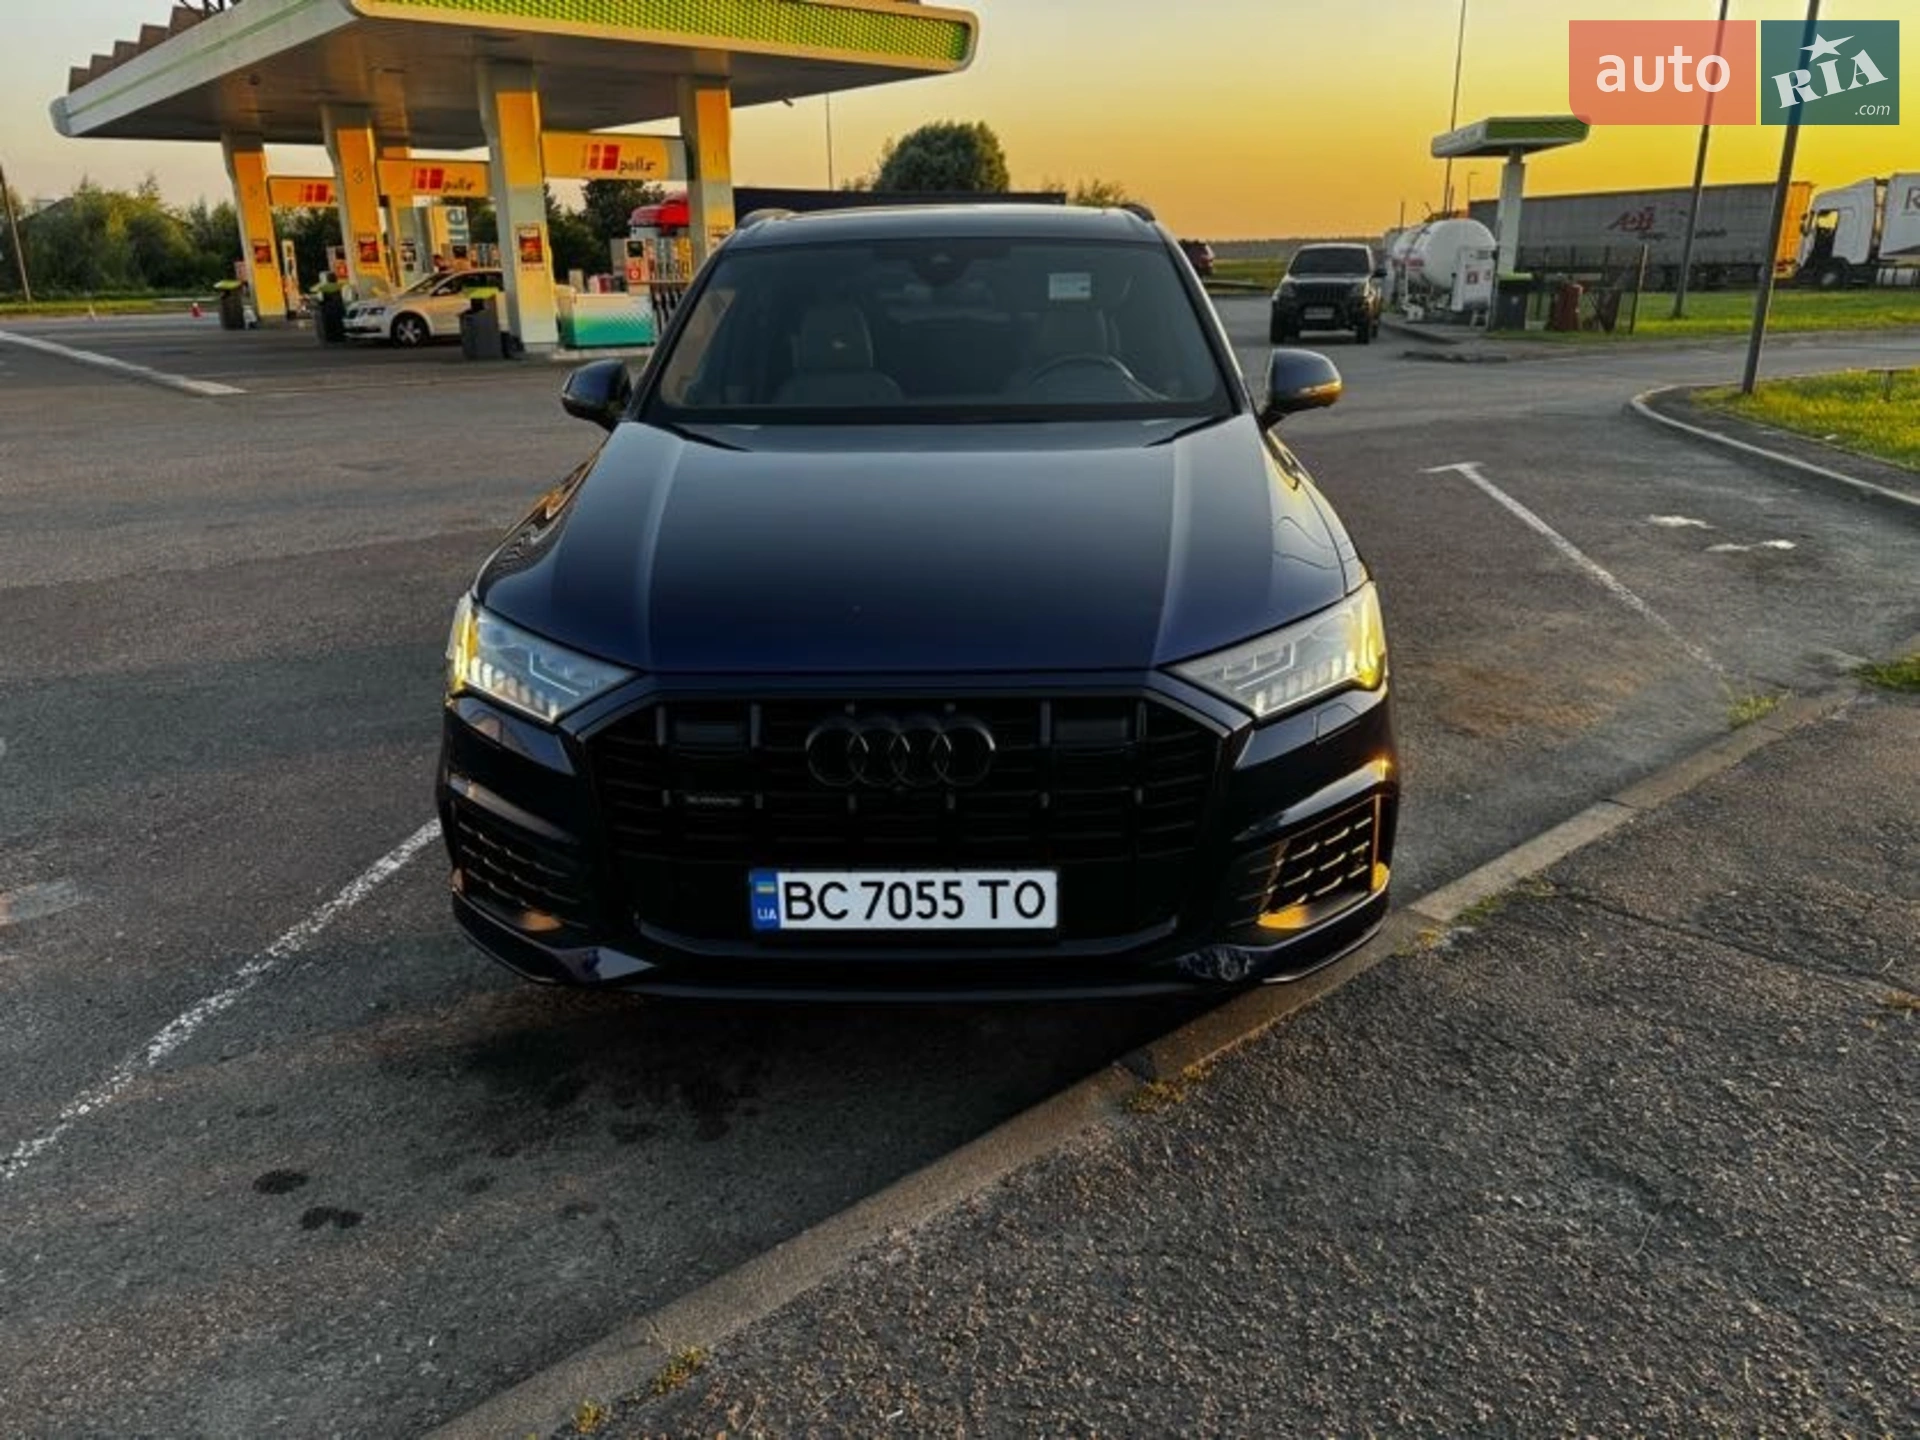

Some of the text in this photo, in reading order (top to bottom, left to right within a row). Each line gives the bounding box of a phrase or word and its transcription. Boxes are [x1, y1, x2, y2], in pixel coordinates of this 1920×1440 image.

[783, 879, 1046, 921] BC 7055 TO
[757, 908, 777, 921] UA
